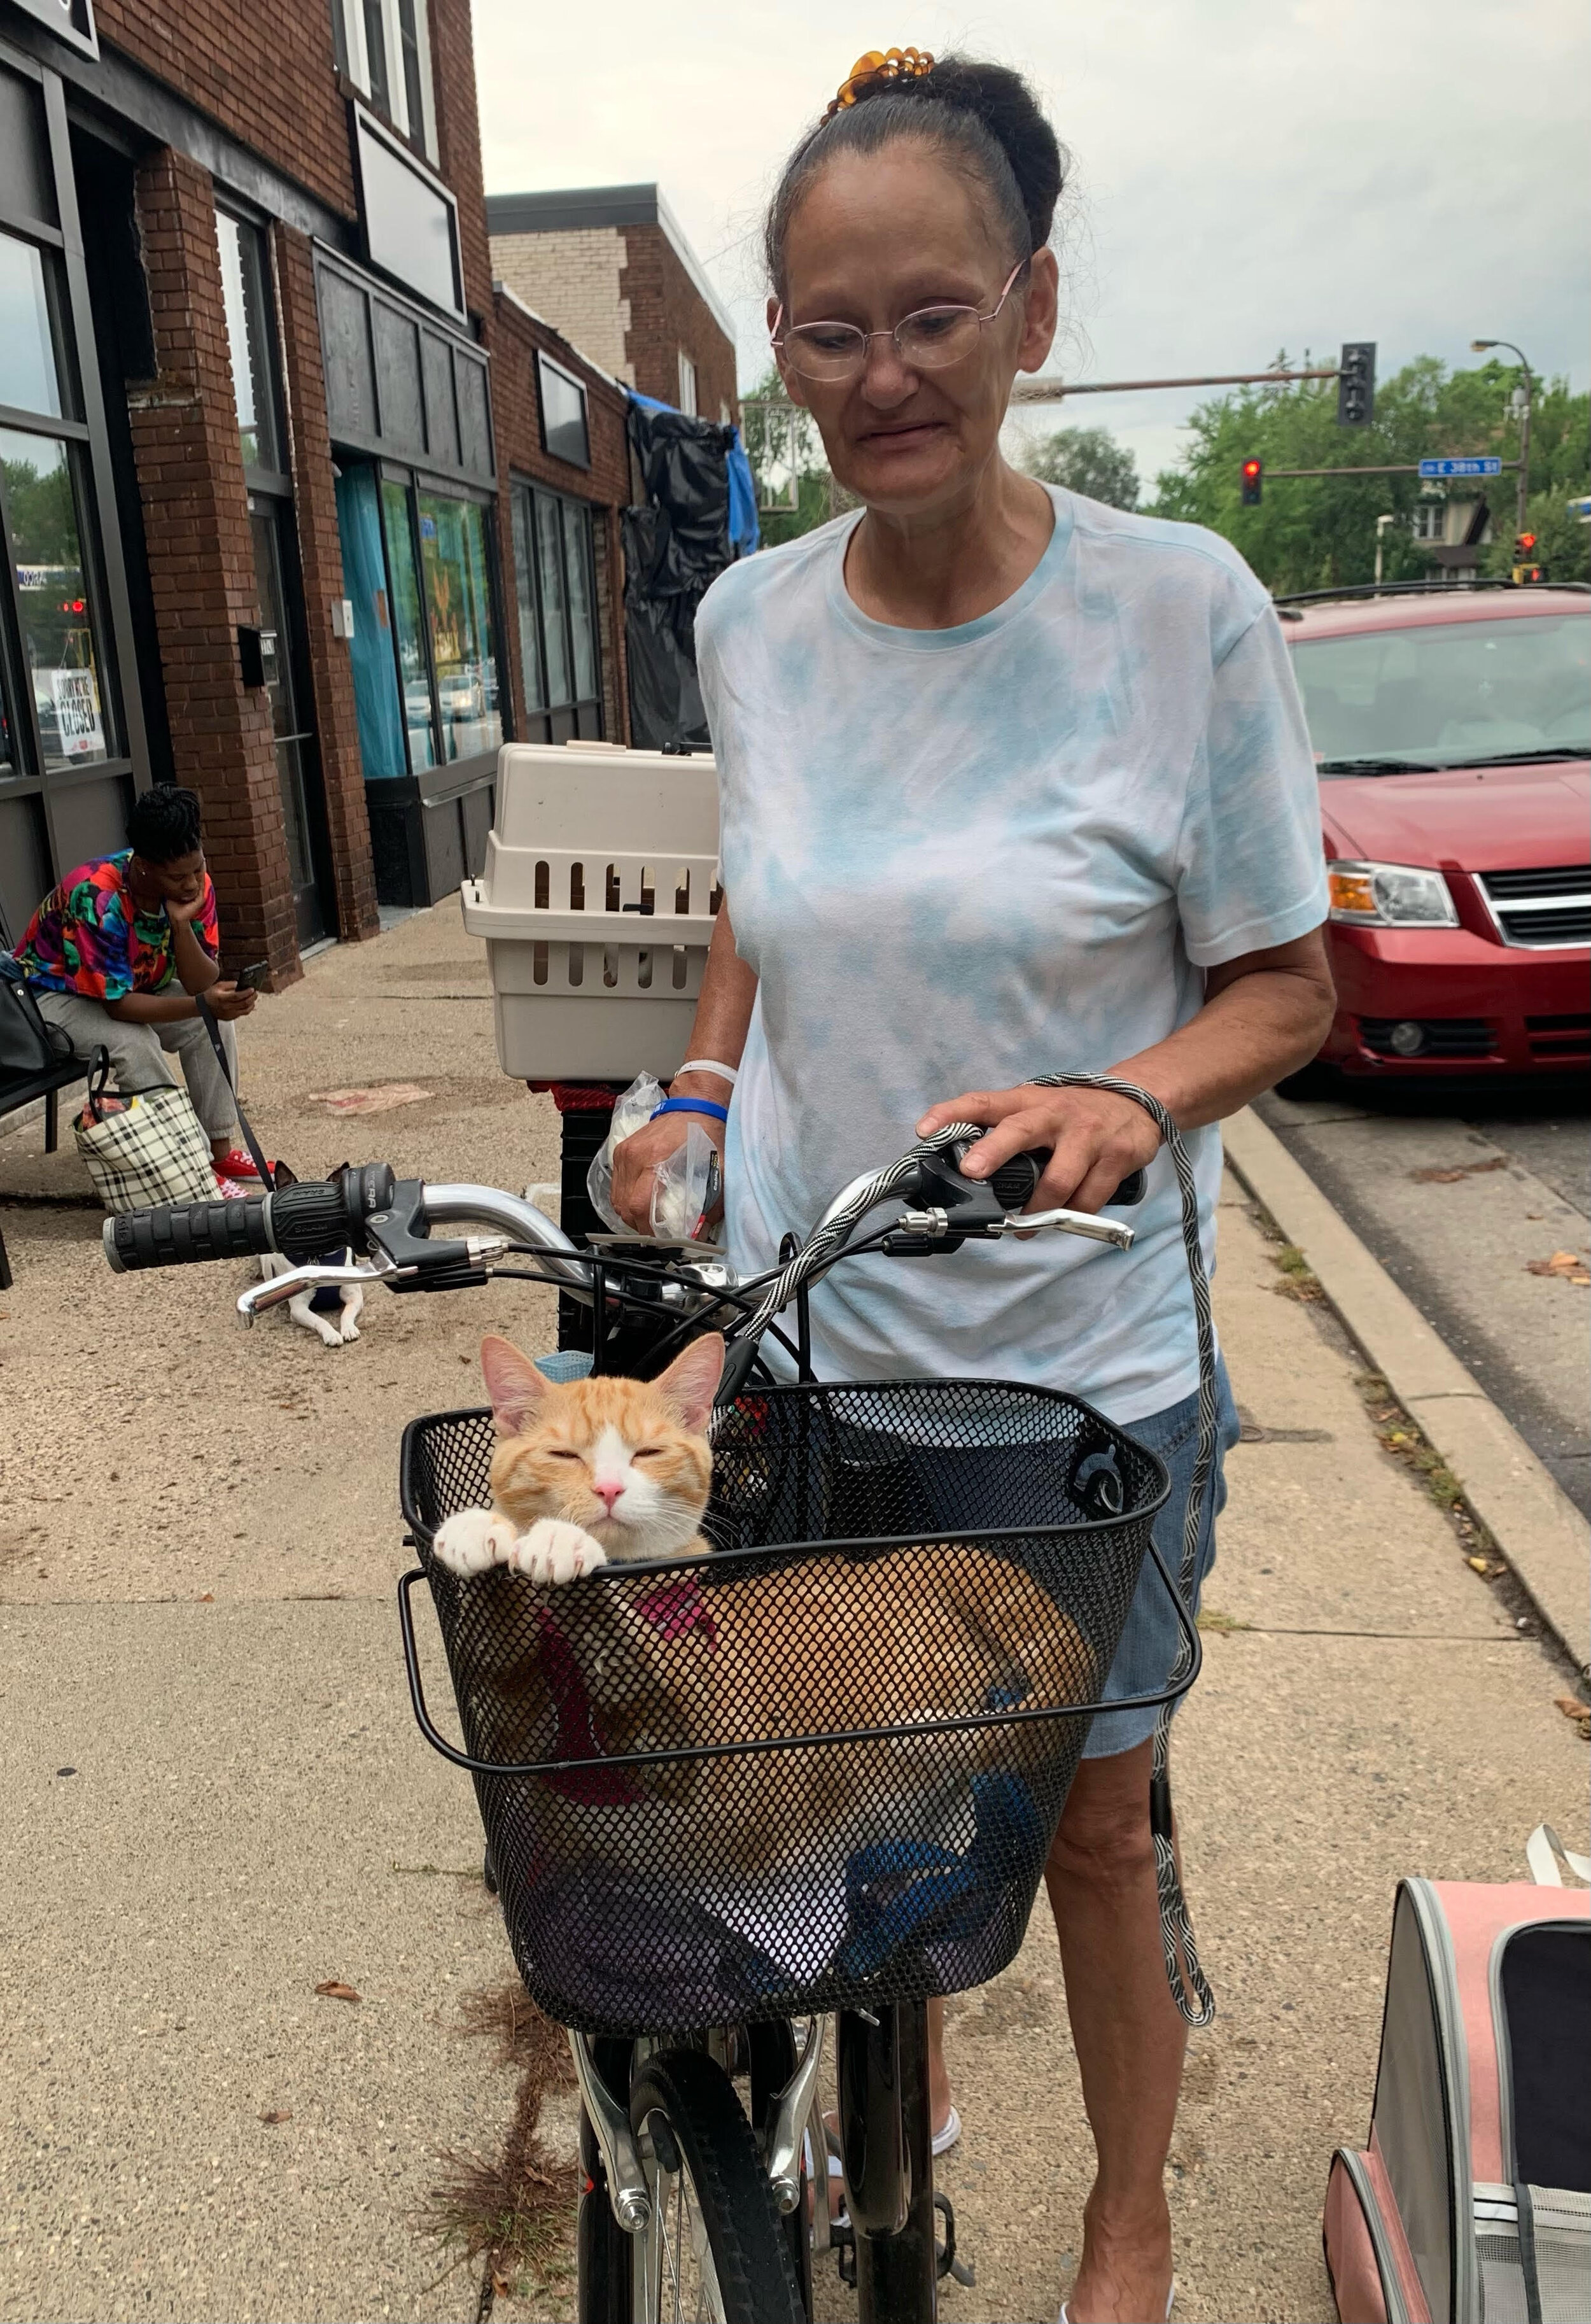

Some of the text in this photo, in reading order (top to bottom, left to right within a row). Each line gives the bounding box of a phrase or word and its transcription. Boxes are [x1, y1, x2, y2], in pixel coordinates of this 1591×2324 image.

[1438, 461, 1497, 474] E 38th St
[60, 698, 95, 736] CLOSED
